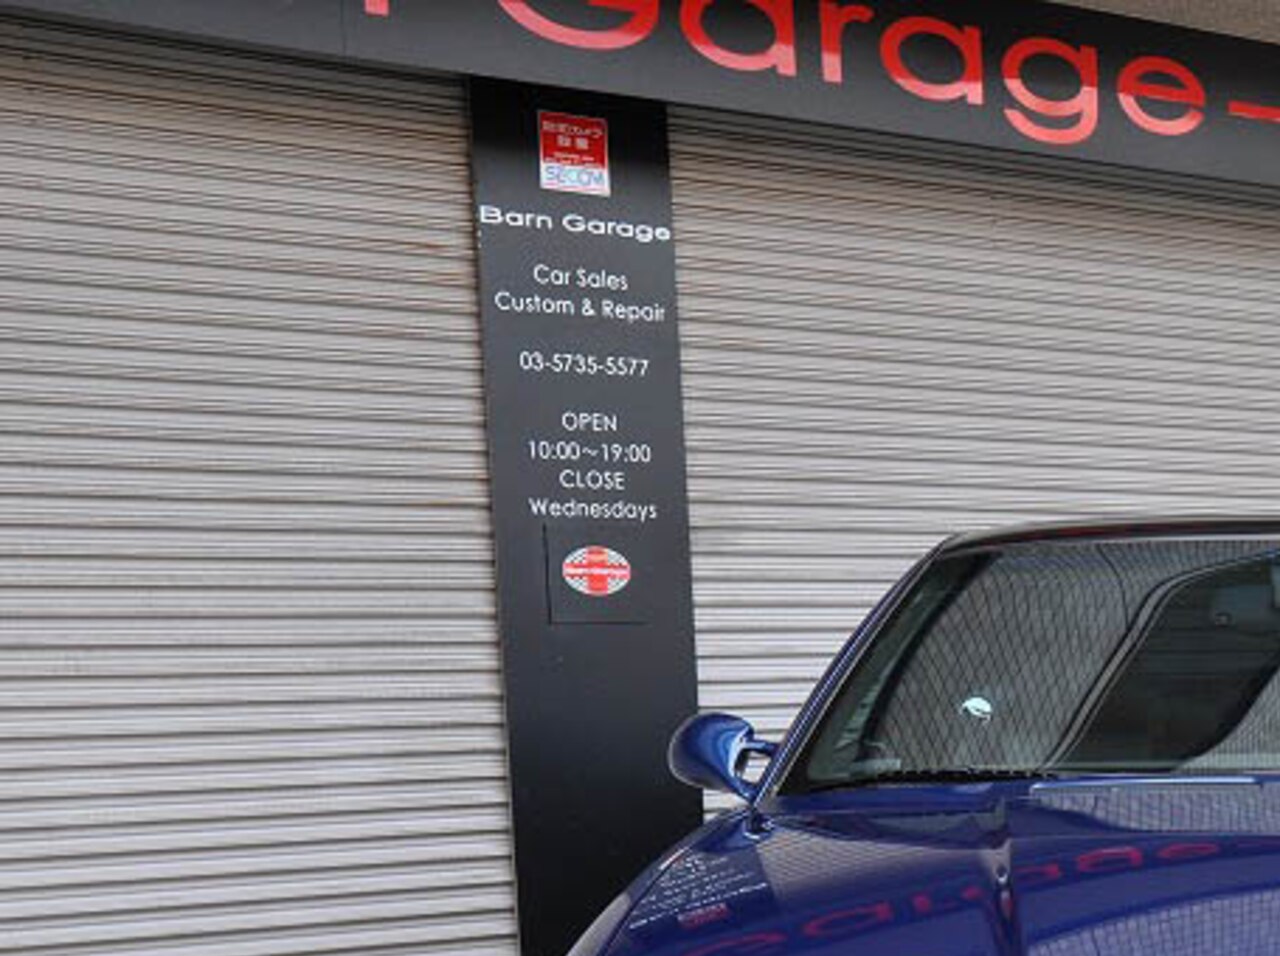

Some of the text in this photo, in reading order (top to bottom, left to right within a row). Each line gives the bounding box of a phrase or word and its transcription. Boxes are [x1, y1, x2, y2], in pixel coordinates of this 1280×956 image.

[480, 205, 670, 242] Barn Garage
[534, 264, 627, 290] Car Sales
[495, 292, 664, 322] Custom & Repair
[520, 351, 648, 375] 03-5735-5577
[562, 413, 616, 431] OPEN
[560, 470, 624, 489] CLOSE
[530, 499, 656, 521] Wednesdays
